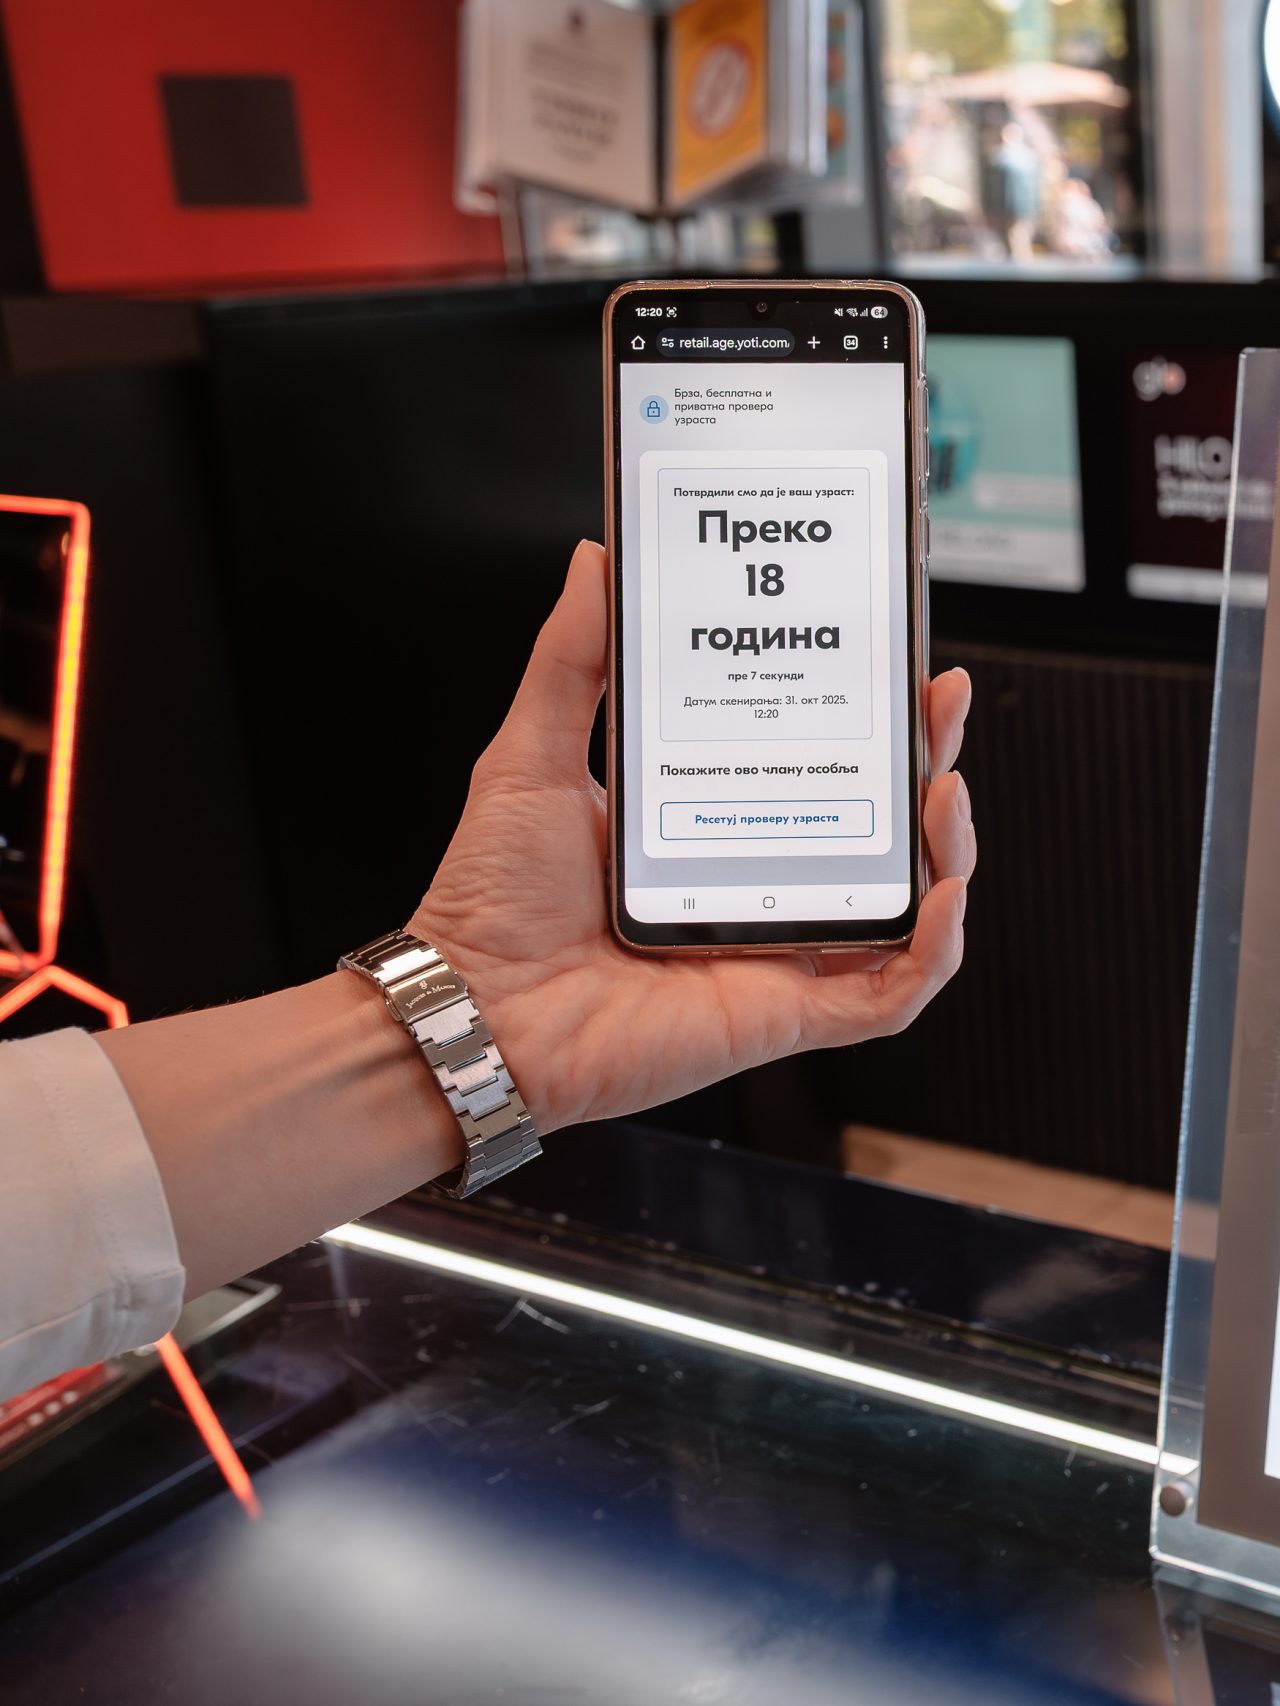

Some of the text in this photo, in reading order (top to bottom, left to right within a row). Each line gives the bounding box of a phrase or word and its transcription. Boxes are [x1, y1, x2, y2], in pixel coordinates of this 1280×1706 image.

[635, 307, 663, 317] 12:20
[674, 388, 703, 400] Брза,
[706, 387, 762, 398] бесплатна
[675, 402, 773, 413] приватна провера
[674, 416, 716, 426] узраста
[674, 488, 734, 499] Потврдили
[760, 489, 774, 498] да
[776, 487, 786, 498] је
[815, 488, 854, 498] узраст:
[698, 510, 832, 552] Преко
[746, 563, 785, 597] 18
[691, 626, 840, 656] година
[728, 670, 804, 682] пре 7 секунди
[683, 694, 848, 708] Датум скенирања: 31. окт 2025.
[754, 709, 779, 719] 12:20
[661, 762, 858, 777] Покажите ово члану особља
[695, 814, 839, 826] Ресетуј проверу узраста
